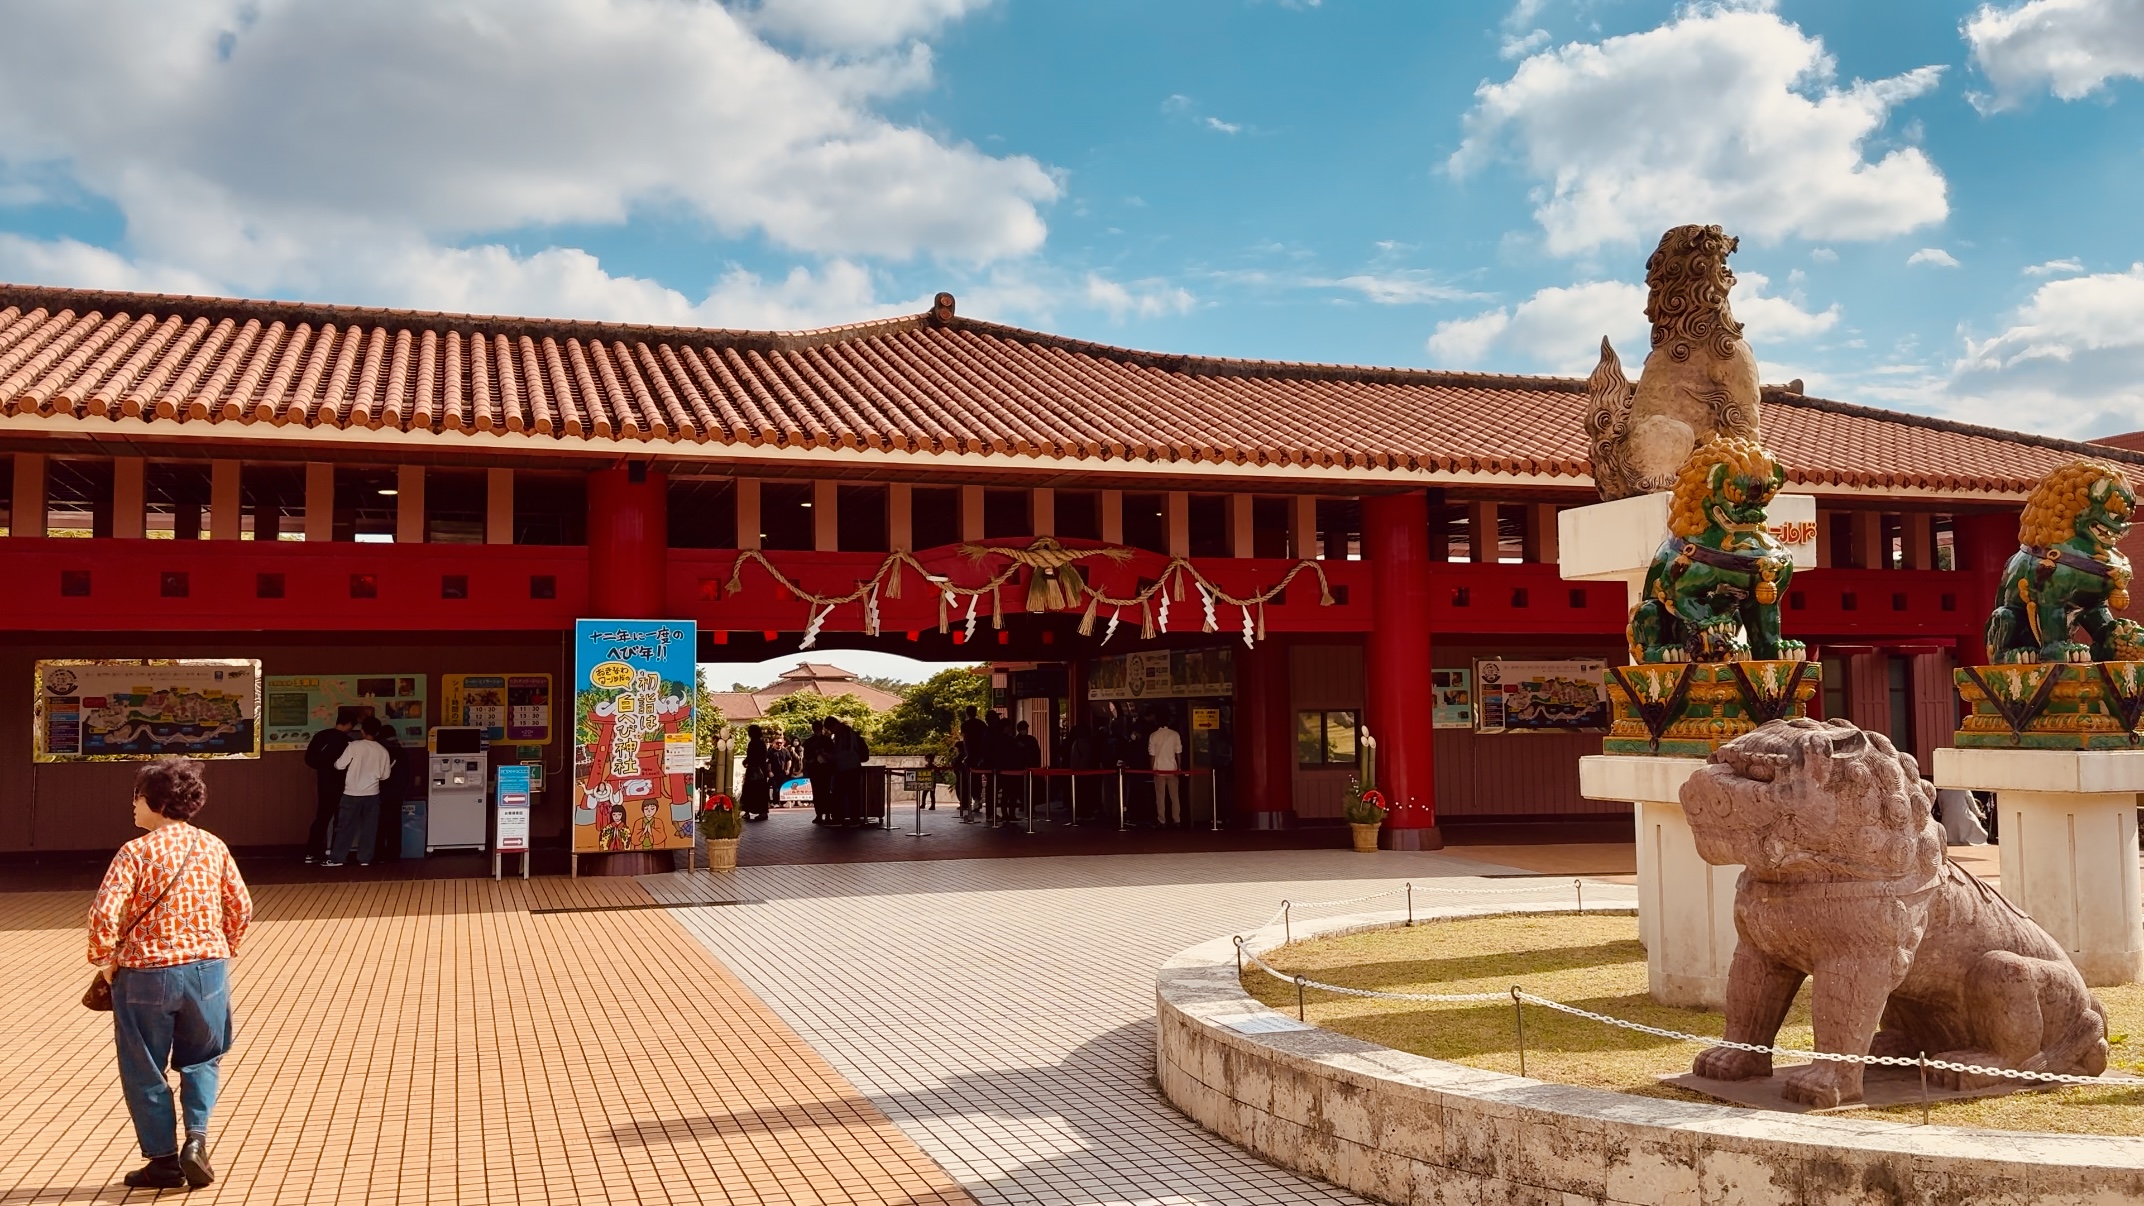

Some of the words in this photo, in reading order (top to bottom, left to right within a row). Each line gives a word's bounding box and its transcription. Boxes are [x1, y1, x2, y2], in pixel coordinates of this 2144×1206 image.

[589, 625, 684, 645] 十二年に一度の
[595, 666, 629, 677] おきなわ
[598, 675, 631, 685] ワールドの
[638, 673, 659, 730] 初詣は
[613, 694, 640, 775] 白へび神社
